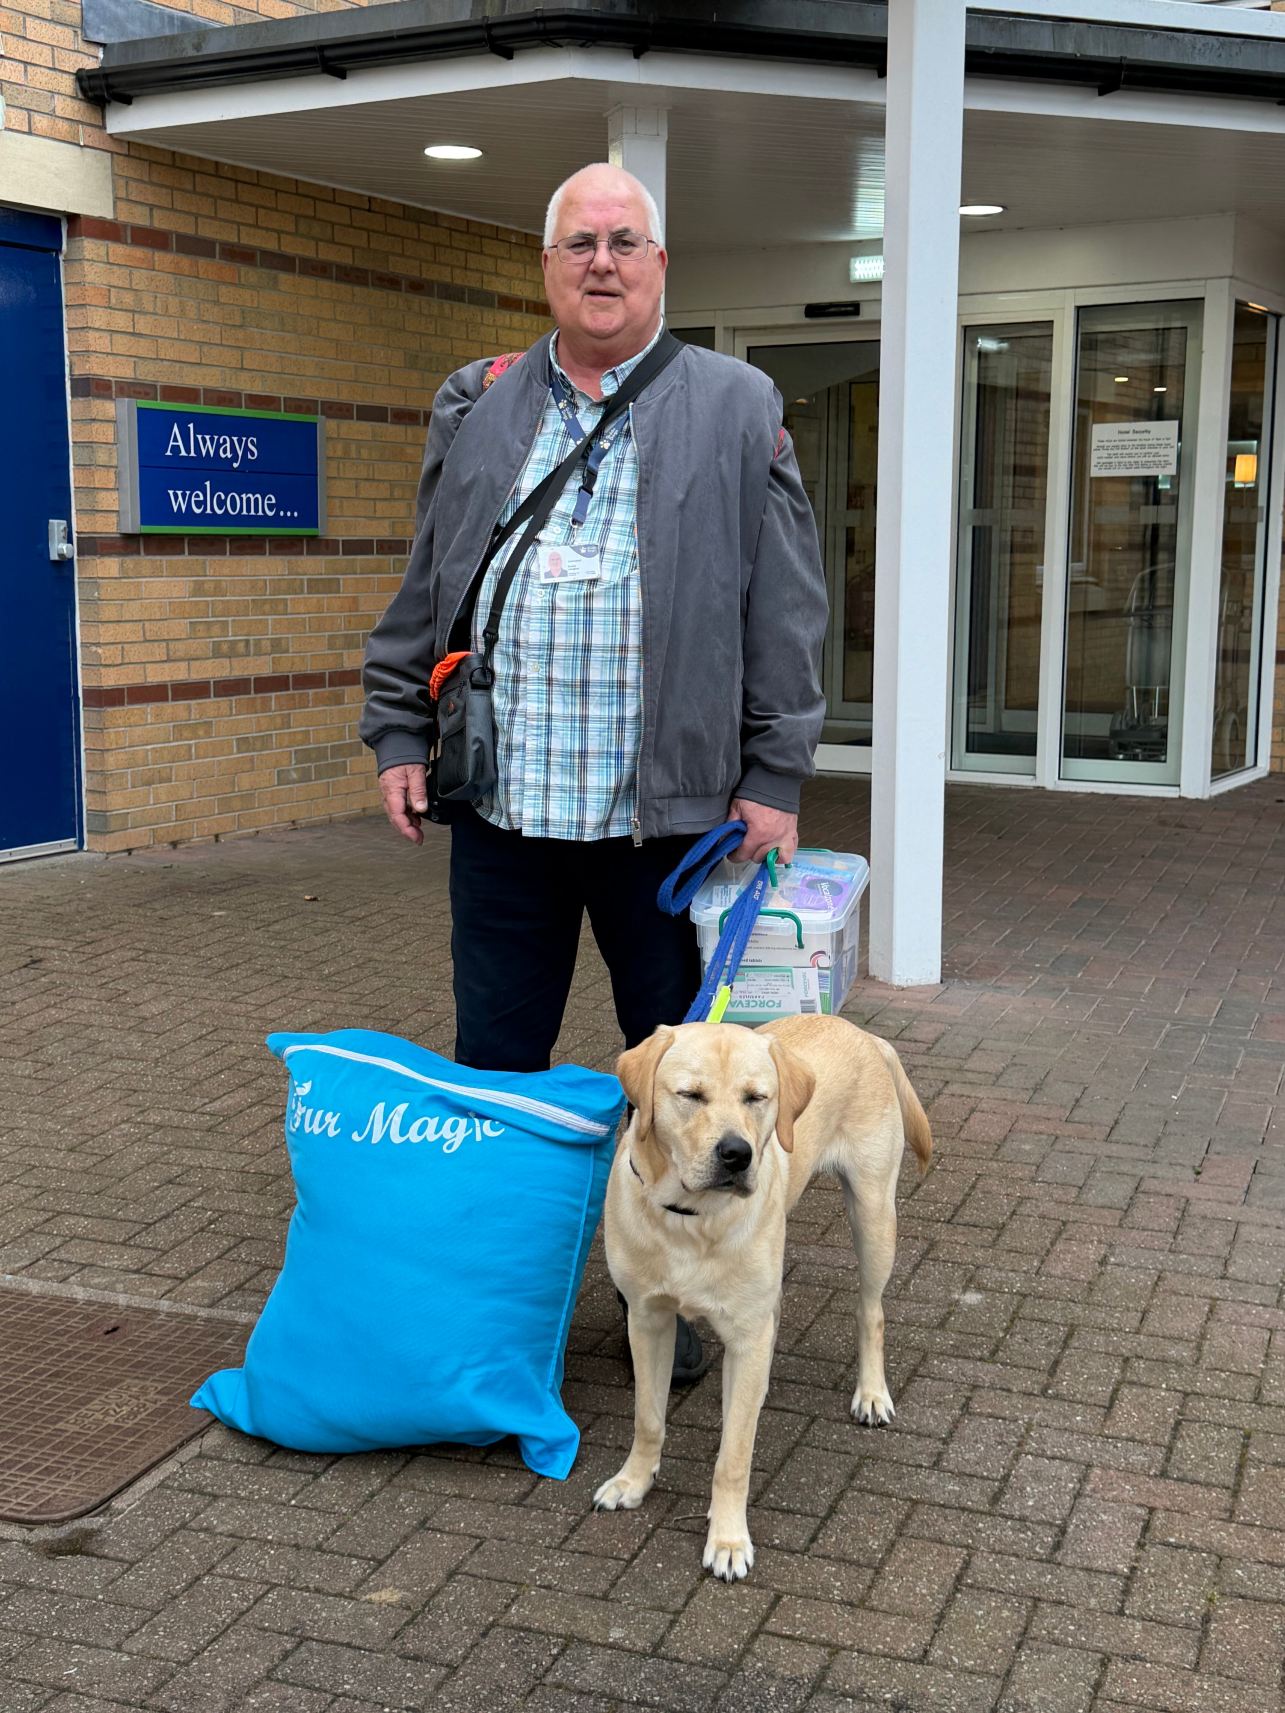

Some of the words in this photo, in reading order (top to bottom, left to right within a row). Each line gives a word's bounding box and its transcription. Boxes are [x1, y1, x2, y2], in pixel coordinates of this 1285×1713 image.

[165, 422, 258, 468] Always
[168, 480, 298, 517] welcome...
[730, 999, 782, 1009] FORCEVA
